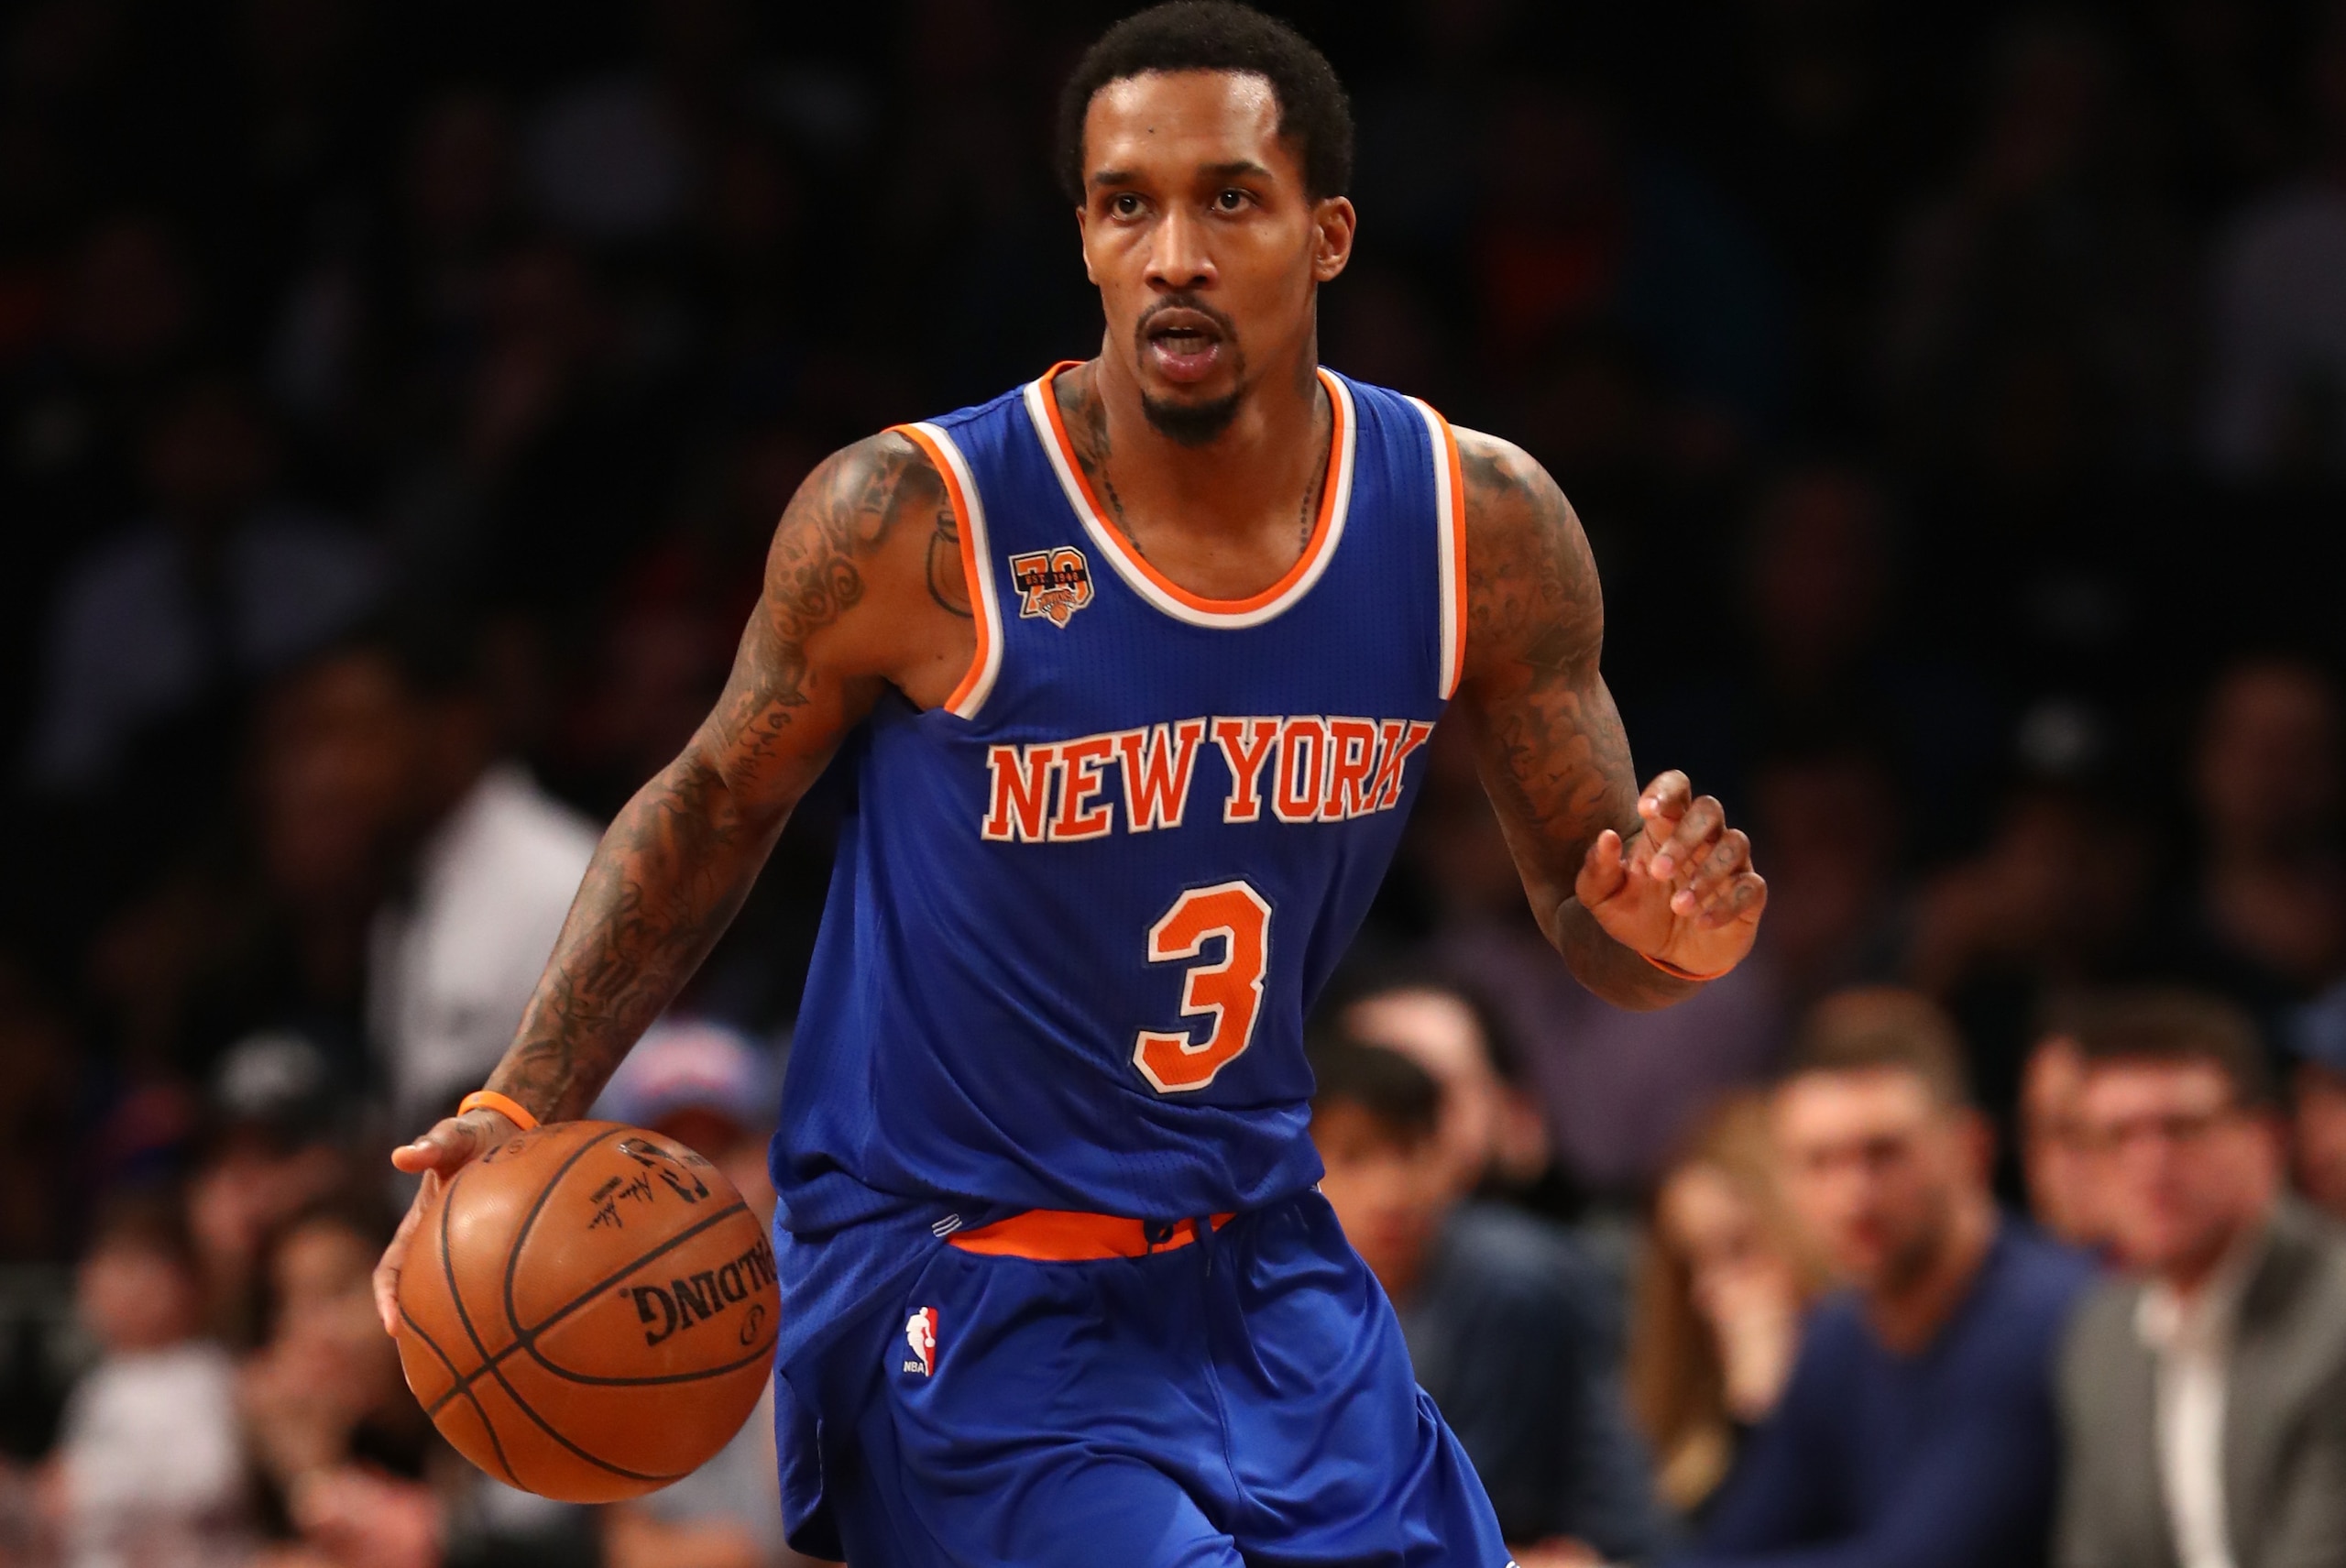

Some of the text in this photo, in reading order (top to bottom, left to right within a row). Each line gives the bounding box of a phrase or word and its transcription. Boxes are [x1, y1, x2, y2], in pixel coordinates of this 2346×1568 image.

[981, 715, 1436, 842] NEW YORK
[1132, 880, 1273, 1094] 3
[631, 1233, 778, 1347] PALDING
[903, 1361, 925, 1374] NBA
